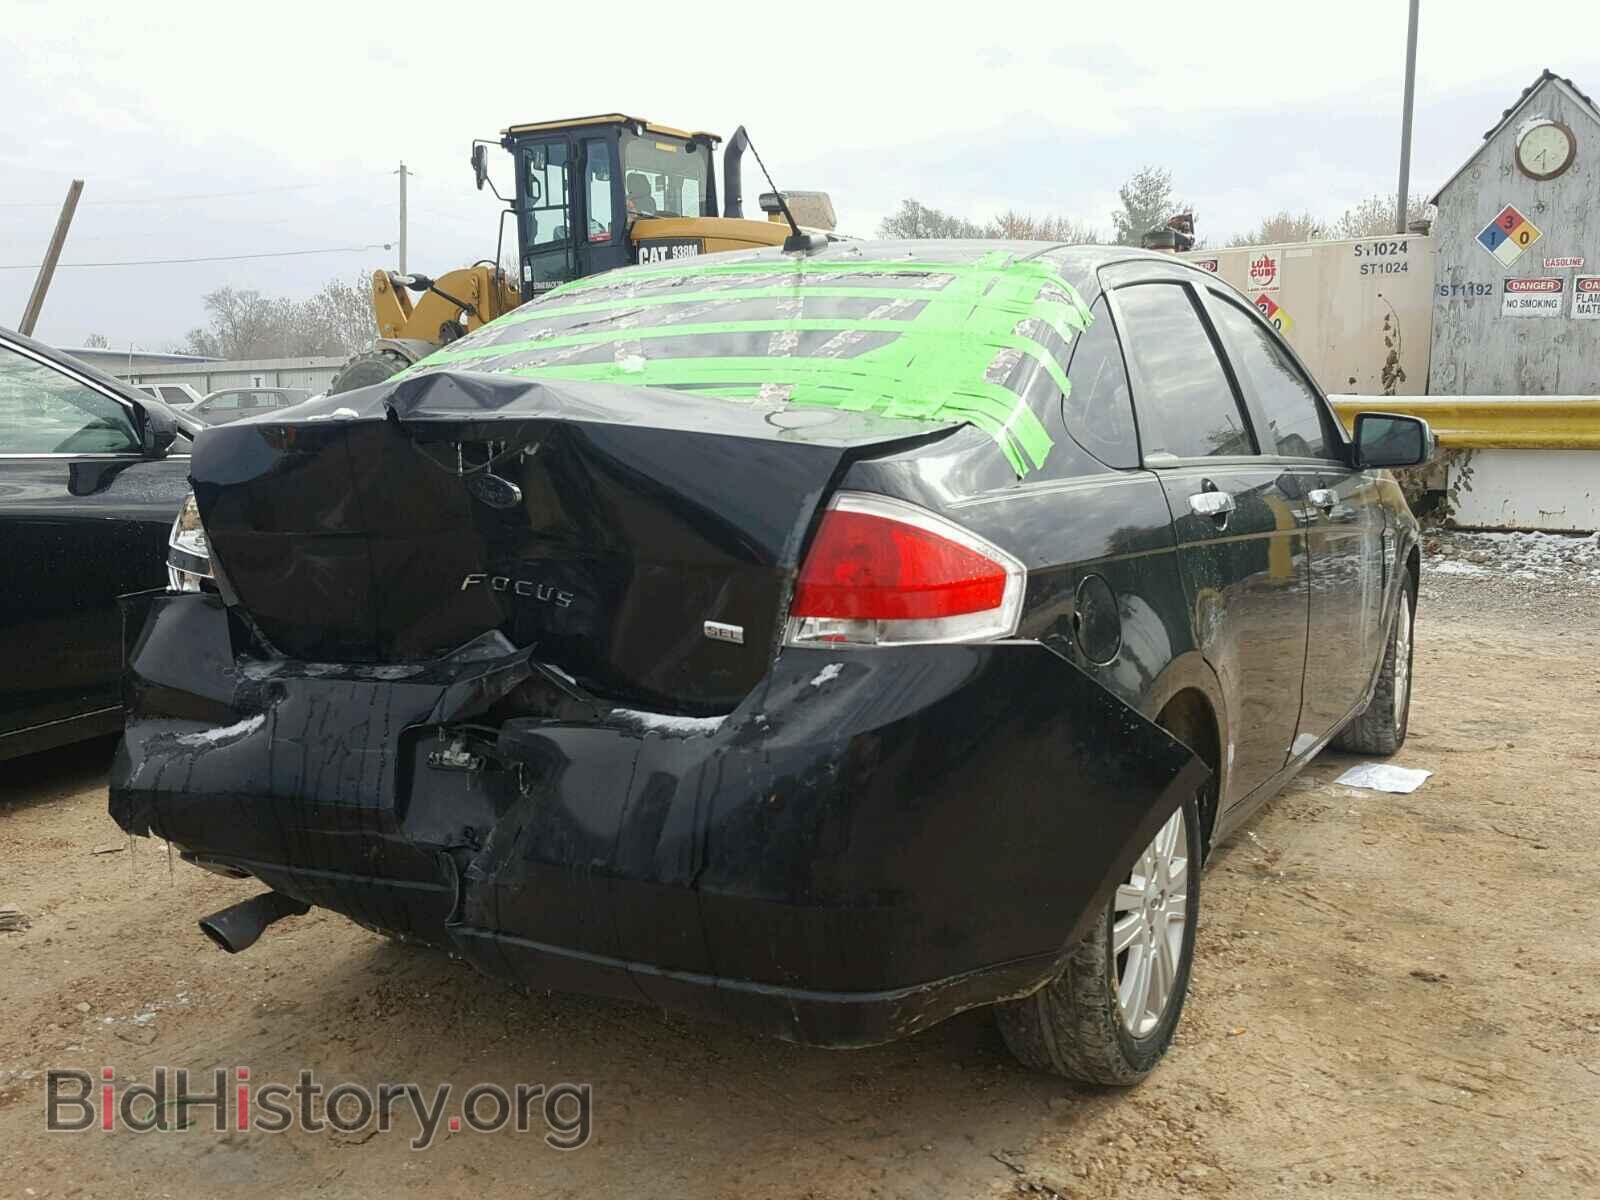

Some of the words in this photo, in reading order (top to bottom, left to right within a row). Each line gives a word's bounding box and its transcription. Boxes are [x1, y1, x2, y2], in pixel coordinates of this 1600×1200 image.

[1504, 215, 1514, 230] 3
[1490, 231, 1497, 245] 1
[1519, 231, 1530, 245] 0
[638, 246, 668, 265] CAT
[672, 244, 698, 259] 938M
[1251, 259, 1276, 269] LUBE
[1360, 261, 1408, 275] ST1024
[1545, 257, 1583, 268] GASOLINE
[1250, 268, 1276, 277] CUBE
[1440, 283, 1493, 297] ST1192
[1512, 281, 1554, 290] DANGER
[1506, 299, 1518, 309] NO
[1520, 299, 1558, 309] SMOKING
[461, 573, 574, 607] FOCUS
